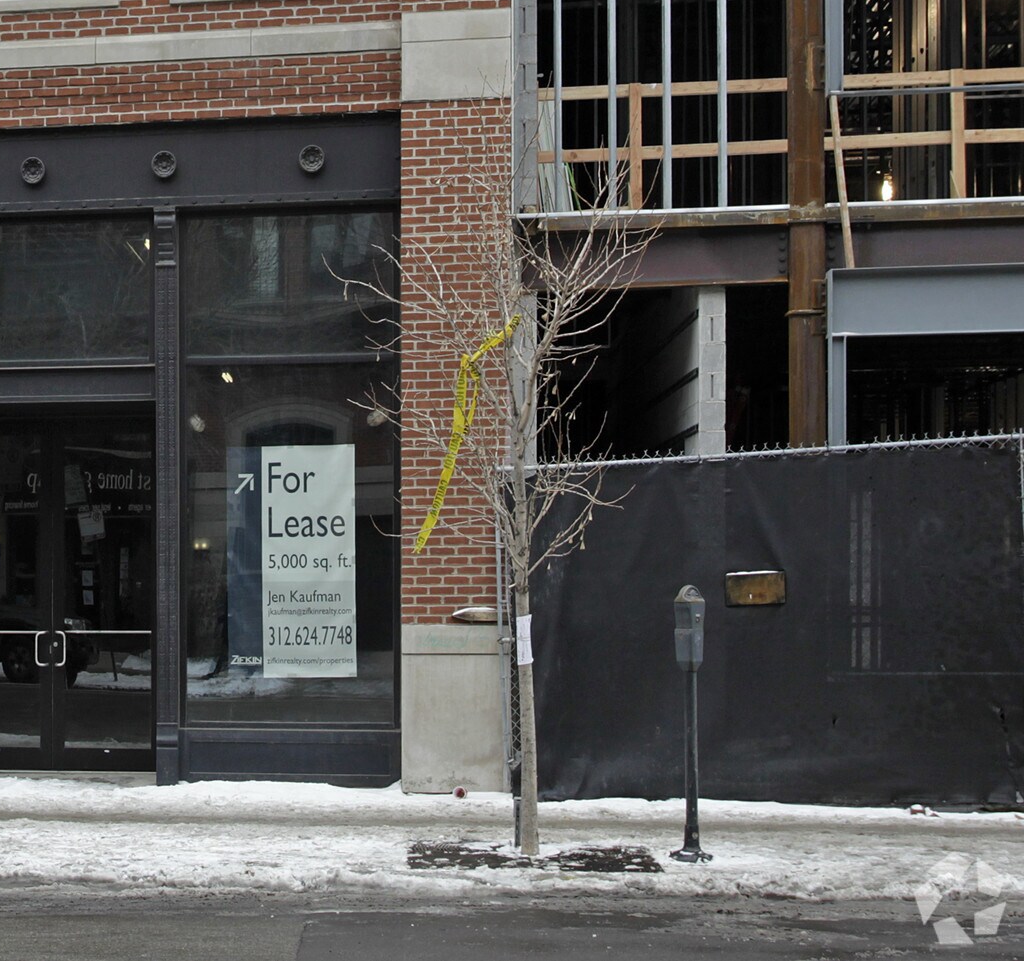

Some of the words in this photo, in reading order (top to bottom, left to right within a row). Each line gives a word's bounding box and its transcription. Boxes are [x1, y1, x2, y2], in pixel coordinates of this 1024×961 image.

[268, 462, 315, 493] For
[268, 507, 345, 537] Lease
[268, 554, 307, 570] 5,000
[313, 558, 332, 572] sq.
[337, 553, 352, 568] ft.
[267, 590, 285, 606] Jen
[290, 590, 341, 603] Kaufman
[268, 625, 353, 646] 312.624.7748
